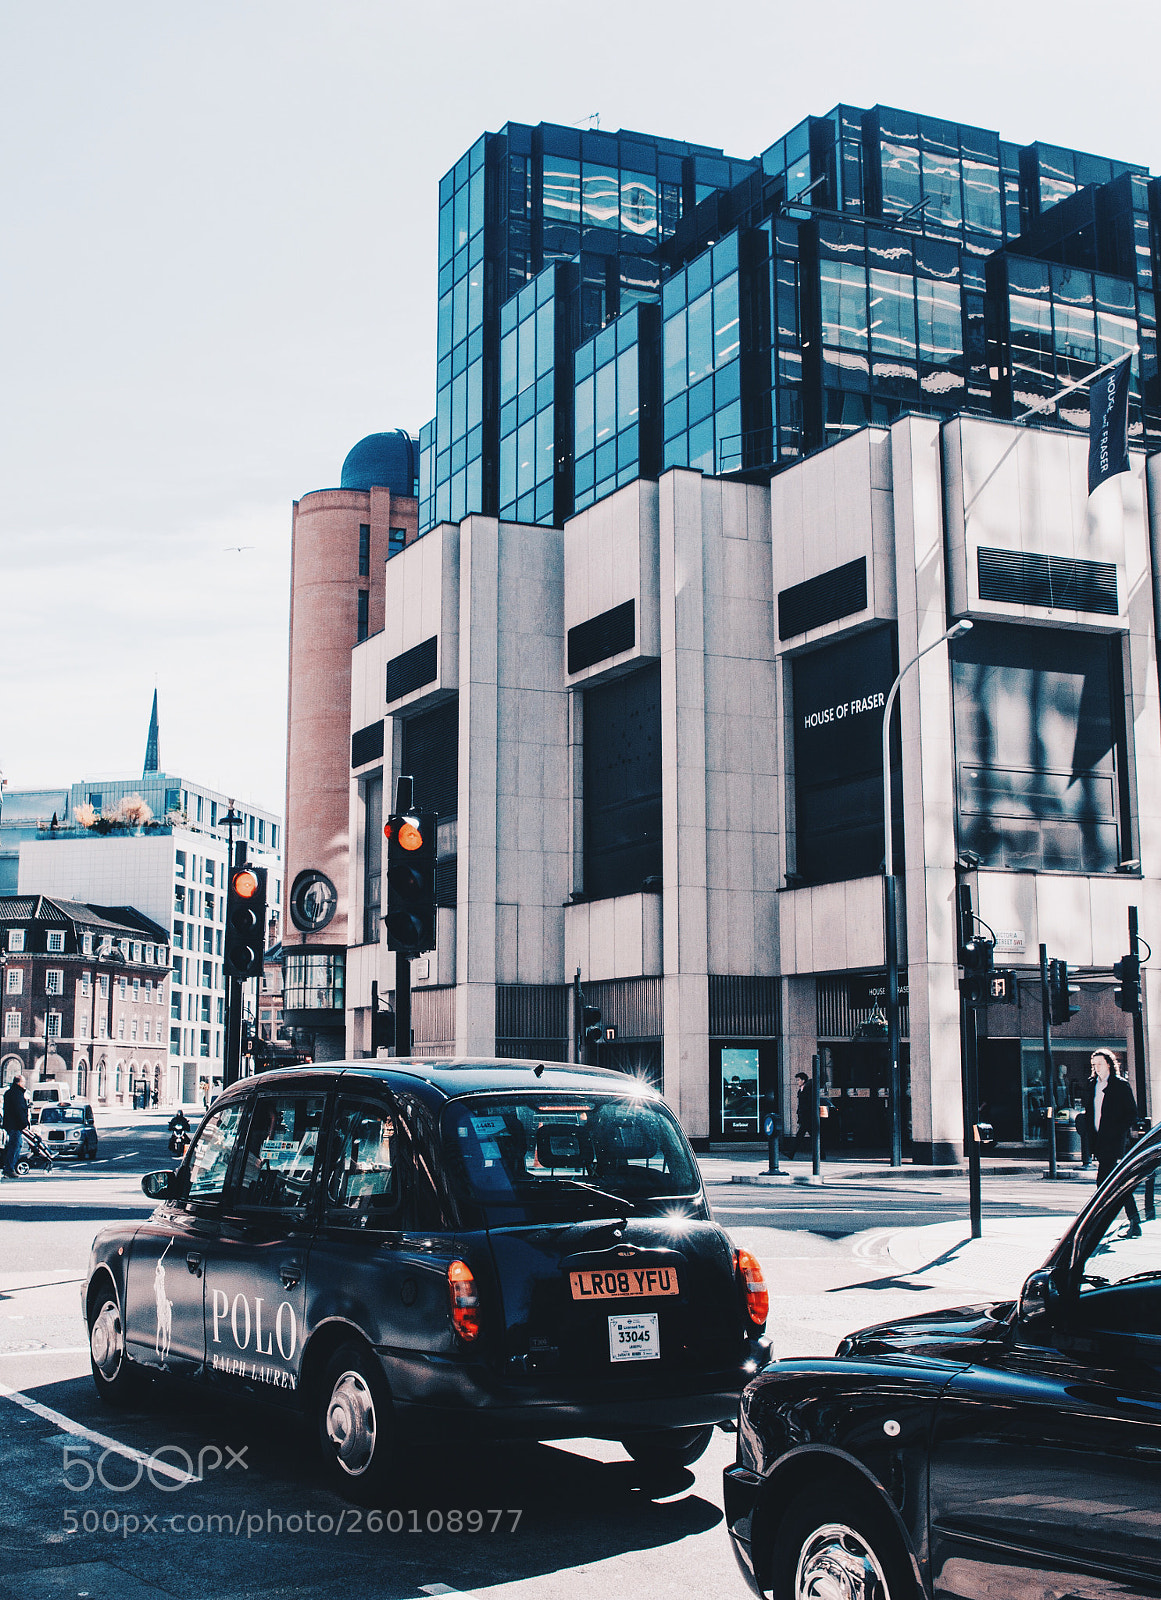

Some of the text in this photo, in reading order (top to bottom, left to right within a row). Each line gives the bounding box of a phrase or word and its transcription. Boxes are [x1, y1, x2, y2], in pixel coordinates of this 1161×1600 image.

[1100, 430, 1109, 473] FRASER
[804, 692, 885, 729] HOUSE OF FRASER
[868, 987, 886, 996] HOUSE
[578, 1270, 671, 1296] LR08 YFU
[212, 1288, 297, 1361] POLO
[618, 1330, 651, 1343] 33045
[212, 1353, 297, 1391] RALPH LAUREN
